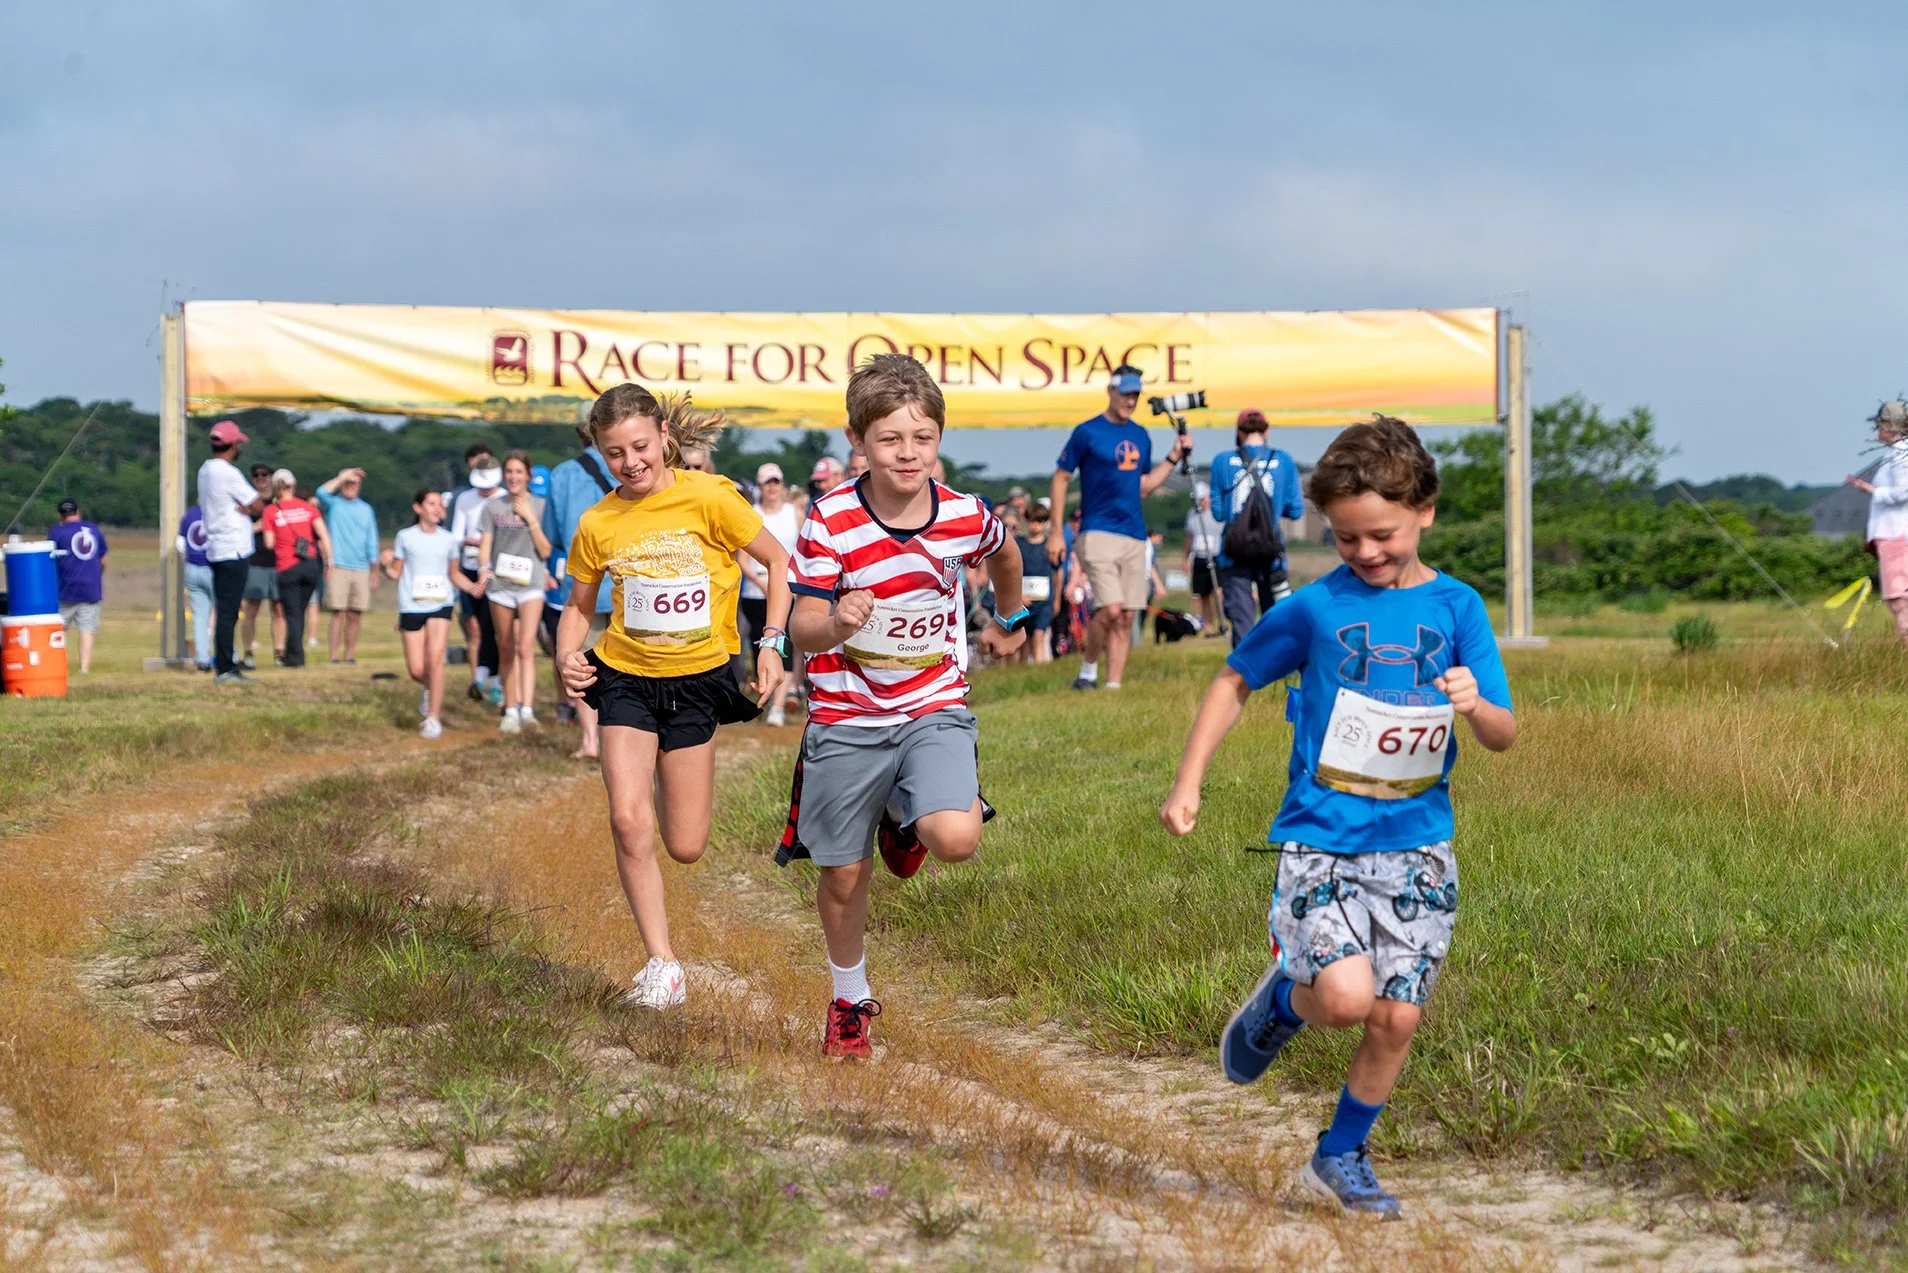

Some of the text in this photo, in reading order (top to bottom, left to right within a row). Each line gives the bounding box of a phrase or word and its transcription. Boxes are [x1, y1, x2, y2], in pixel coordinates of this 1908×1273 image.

[550, 329, 702, 395] RACE
[725, 341, 834, 386] FOR
[1020, 338, 1193, 391] SPACE
[632, 597, 643, 609] 25
[653, 589, 706, 614] 669
[887, 613, 945, 639] 269
[897, 643, 929, 653] George
[1342, 724, 1362, 742] 25
[1377, 724, 1447, 756] 670
